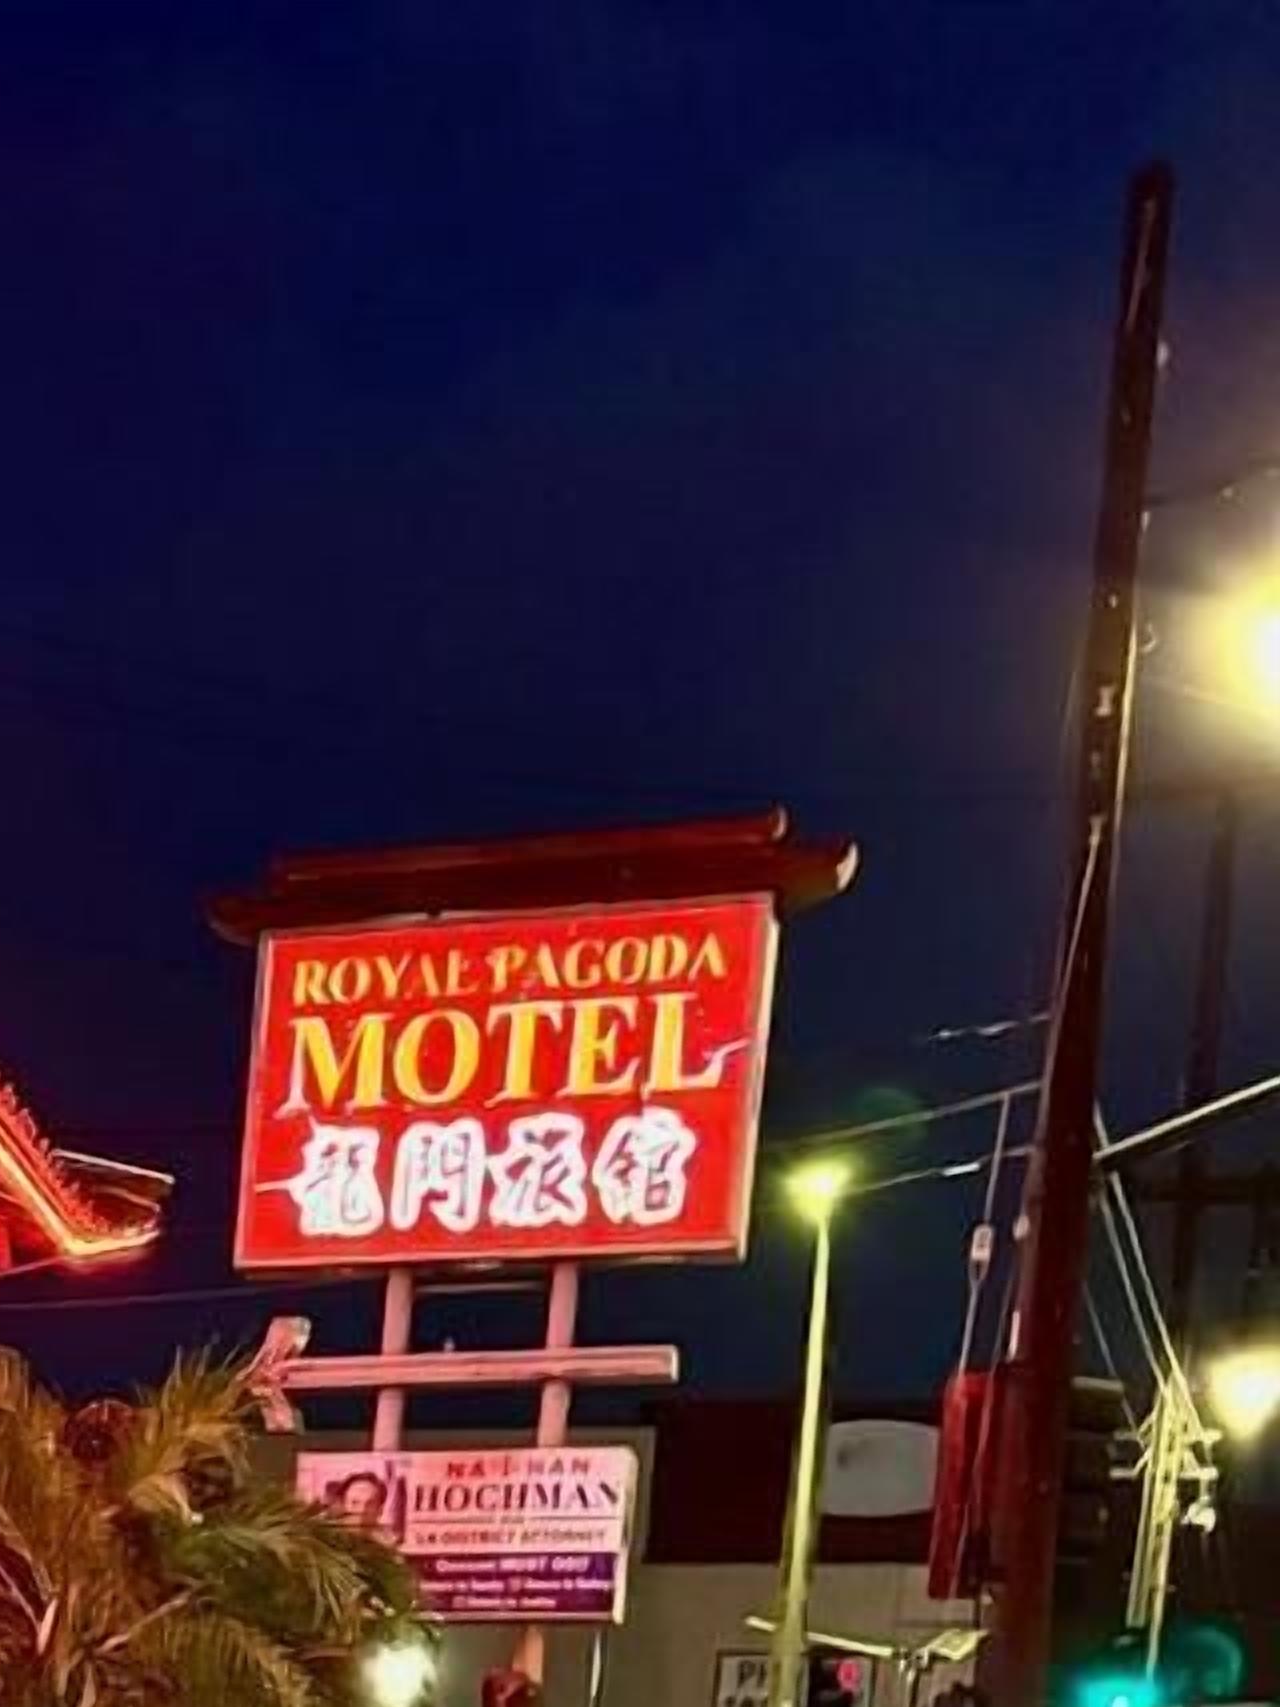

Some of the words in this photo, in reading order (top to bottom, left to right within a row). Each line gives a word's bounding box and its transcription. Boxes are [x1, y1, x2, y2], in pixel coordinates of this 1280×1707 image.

[293, 949, 478, 1007] ROYAL
[485, 932, 728, 993] PAGODA
[276, 991, 730, 1114] MOTEL
[414, 1481, 620, 1513] HOCHMAN
